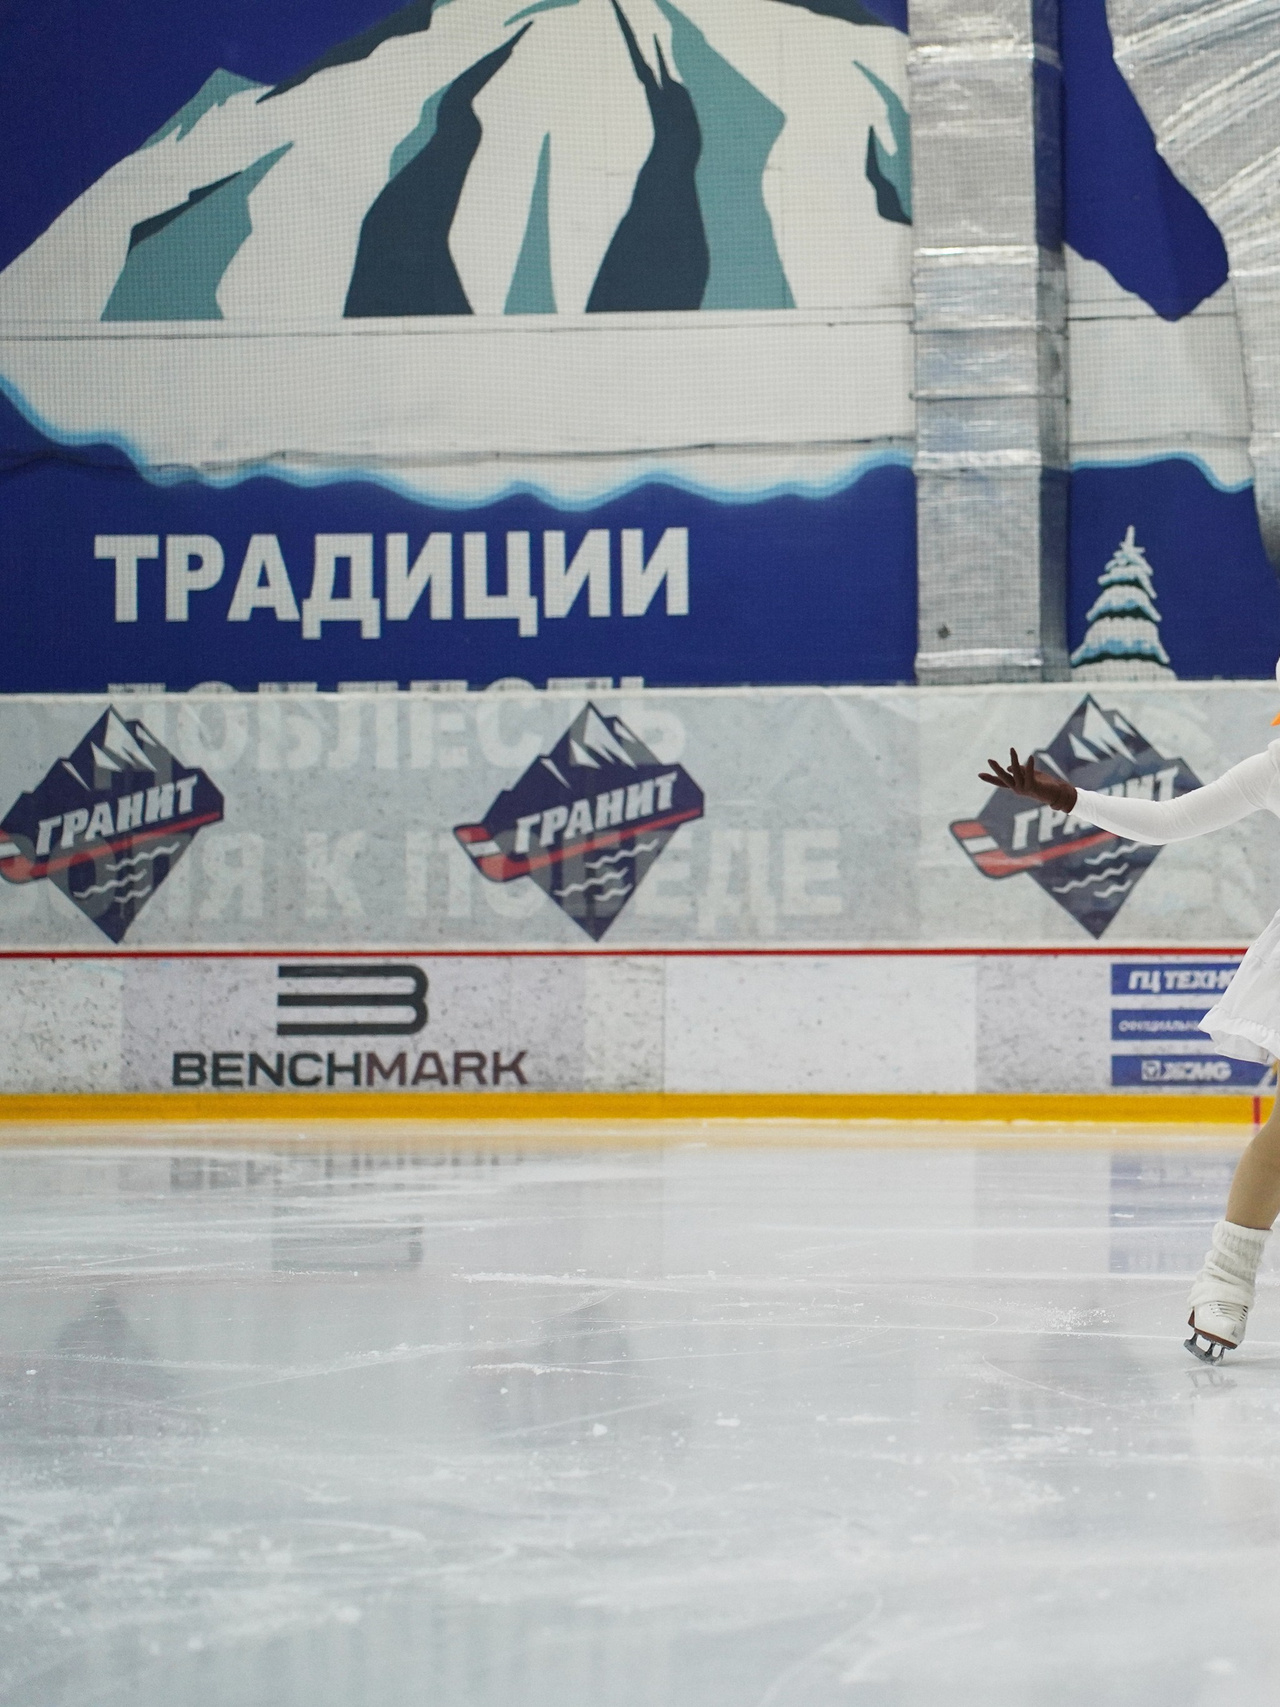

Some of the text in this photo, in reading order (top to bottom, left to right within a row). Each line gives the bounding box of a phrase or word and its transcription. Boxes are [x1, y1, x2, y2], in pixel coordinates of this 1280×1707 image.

[94, 527, 689, 640] ТРАДИЦИИ
[35, 774, 199, 857] ГРАНИТ
[513, 771, 679, 855] ГРАНИТ
[305, 830, 365, 918] К
[171, 1051, 530, 1087] BENCHMARK
